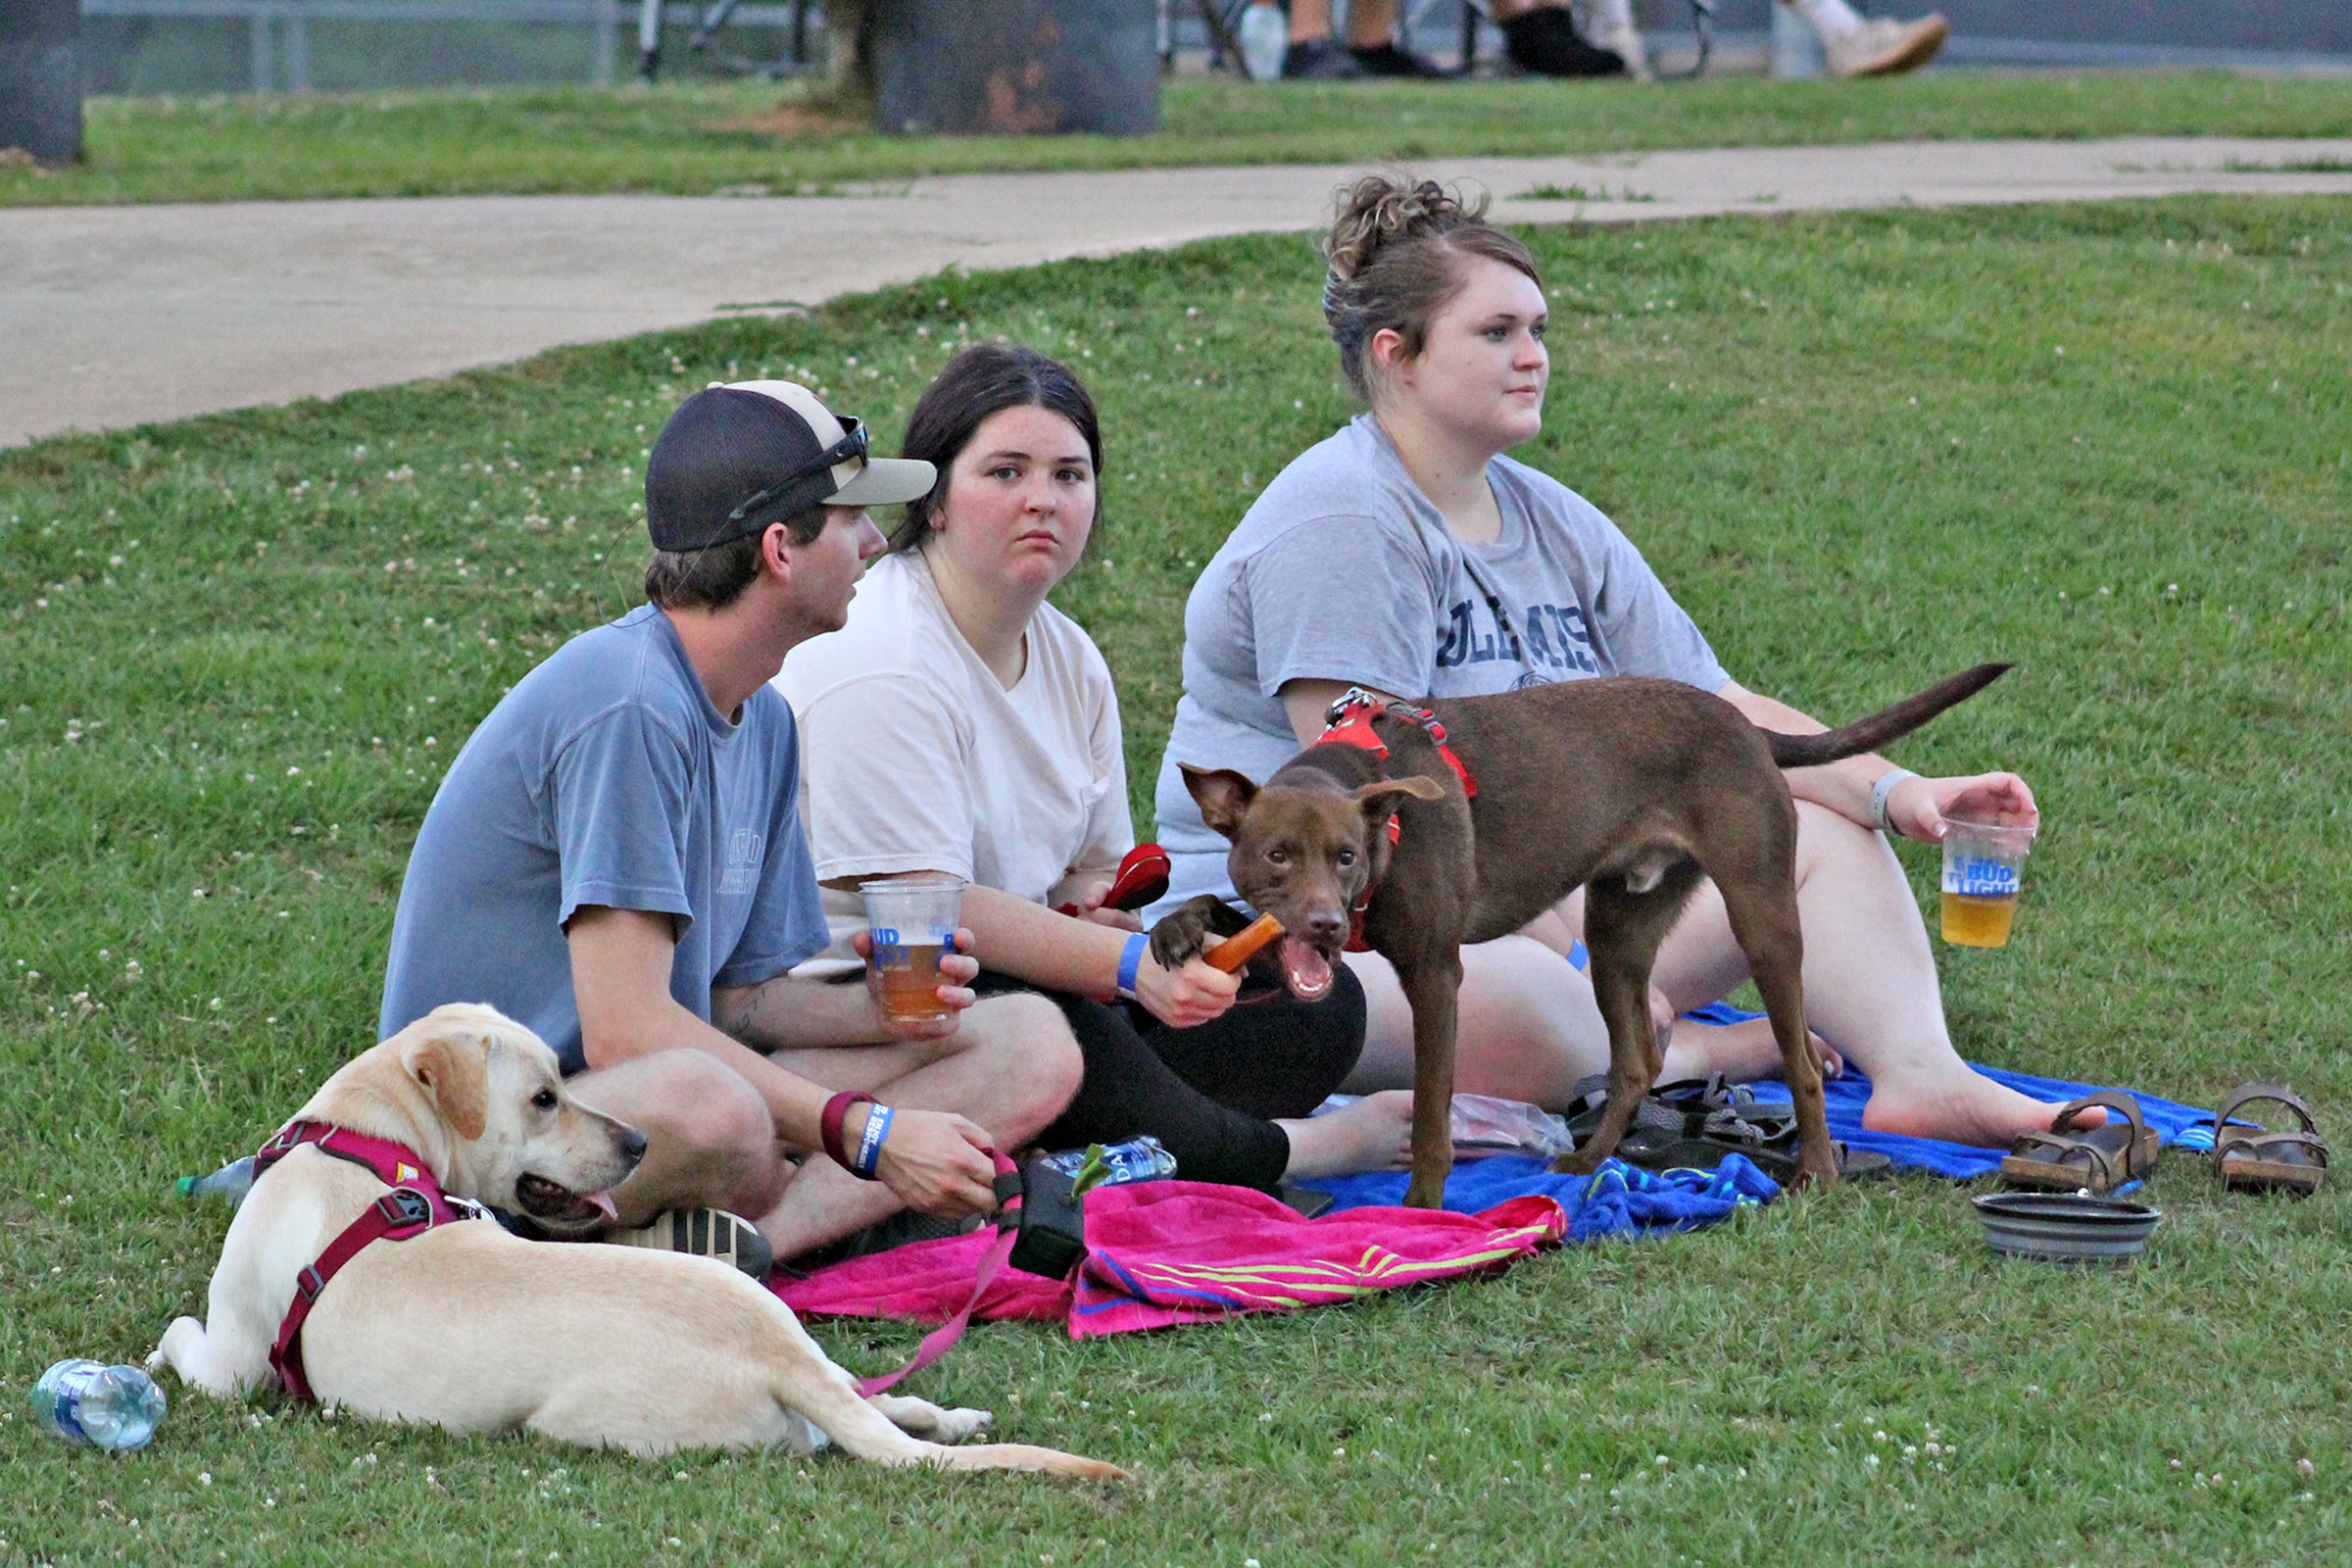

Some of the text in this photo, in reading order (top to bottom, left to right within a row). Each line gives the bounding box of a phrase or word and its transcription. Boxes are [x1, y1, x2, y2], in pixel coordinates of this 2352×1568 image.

[1520, 604, 1600, 672] MIS
[1967, 863, 2012, 882] BUD
[1958, 879, 2015, 899] LIGHT
[871, 928, 900, 945] UD
